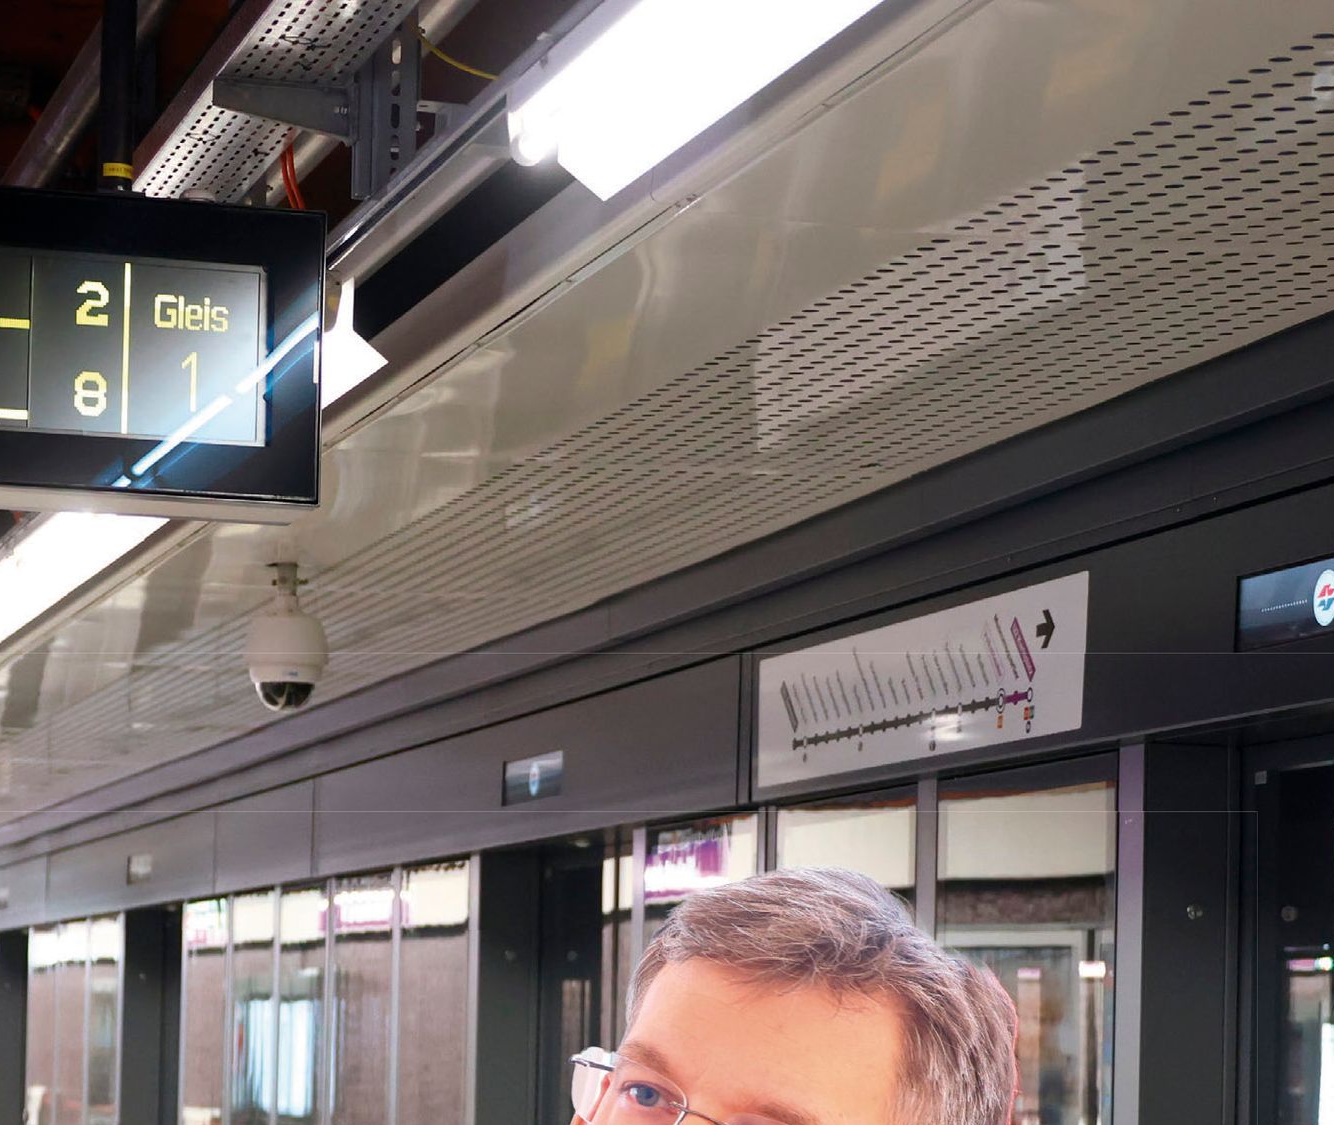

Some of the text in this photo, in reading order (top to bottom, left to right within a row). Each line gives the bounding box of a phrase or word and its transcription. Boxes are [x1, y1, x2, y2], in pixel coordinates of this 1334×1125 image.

[75, 280, 109, 327] 2
[154, 294, 229, 332] Gleis
[74, 371, 107, 417] 8
[181, 351, 197, 412] 1
